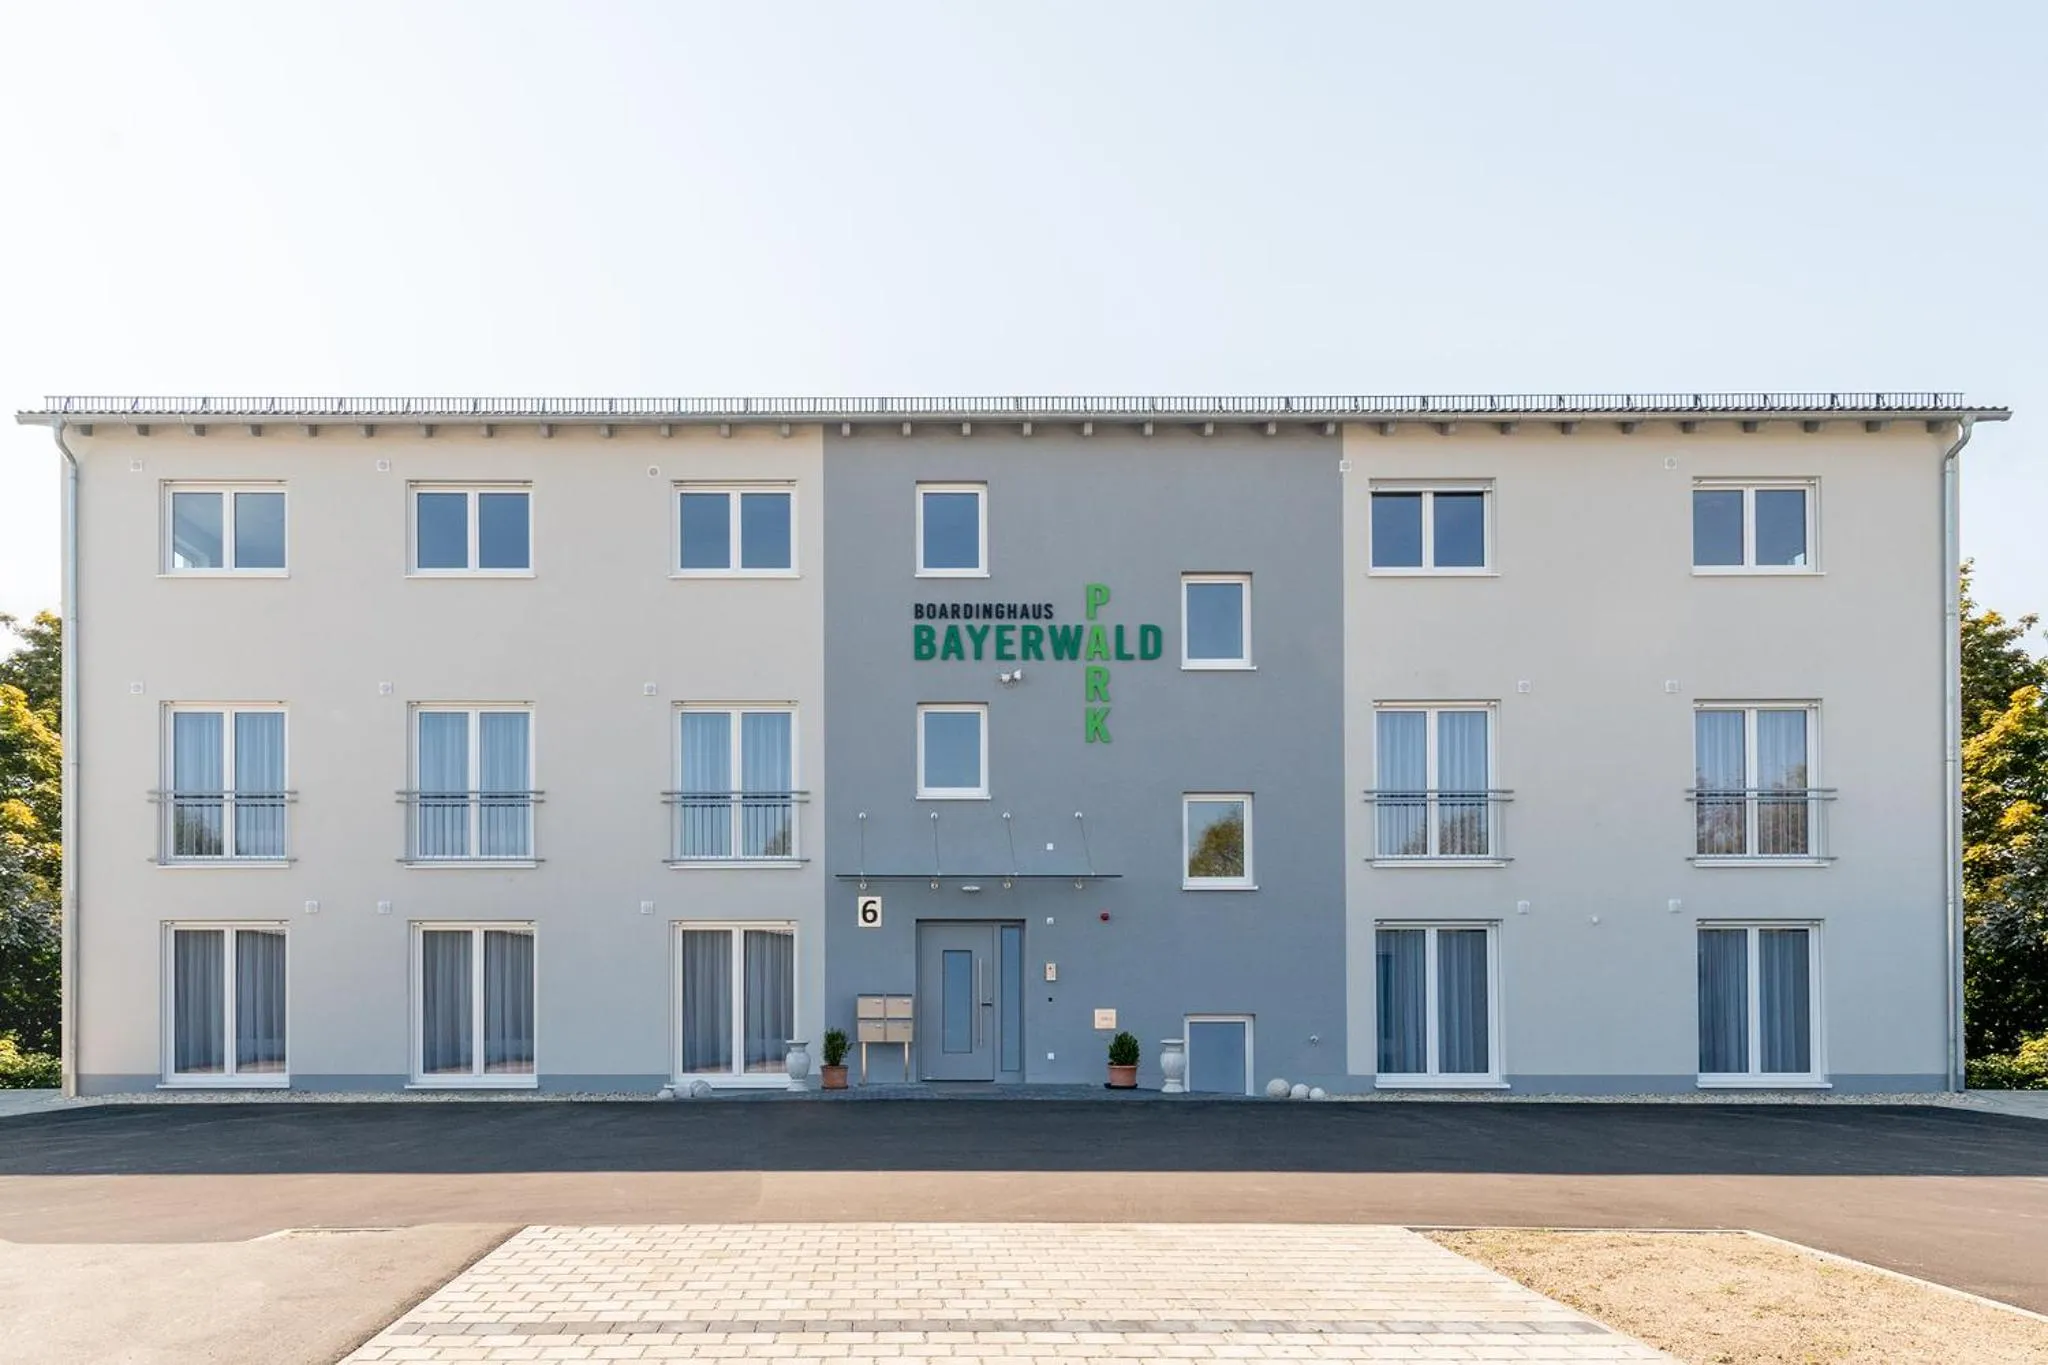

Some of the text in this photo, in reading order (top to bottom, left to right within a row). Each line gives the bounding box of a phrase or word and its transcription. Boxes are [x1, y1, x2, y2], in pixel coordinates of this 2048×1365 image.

[914, 603, 1054, 620] BOARDINGHAUS
[913, 624, 1163, 661] BAYERWALD
[1085, 583, 1111, 743] PARK
[862, 900, 878, 924] 6
